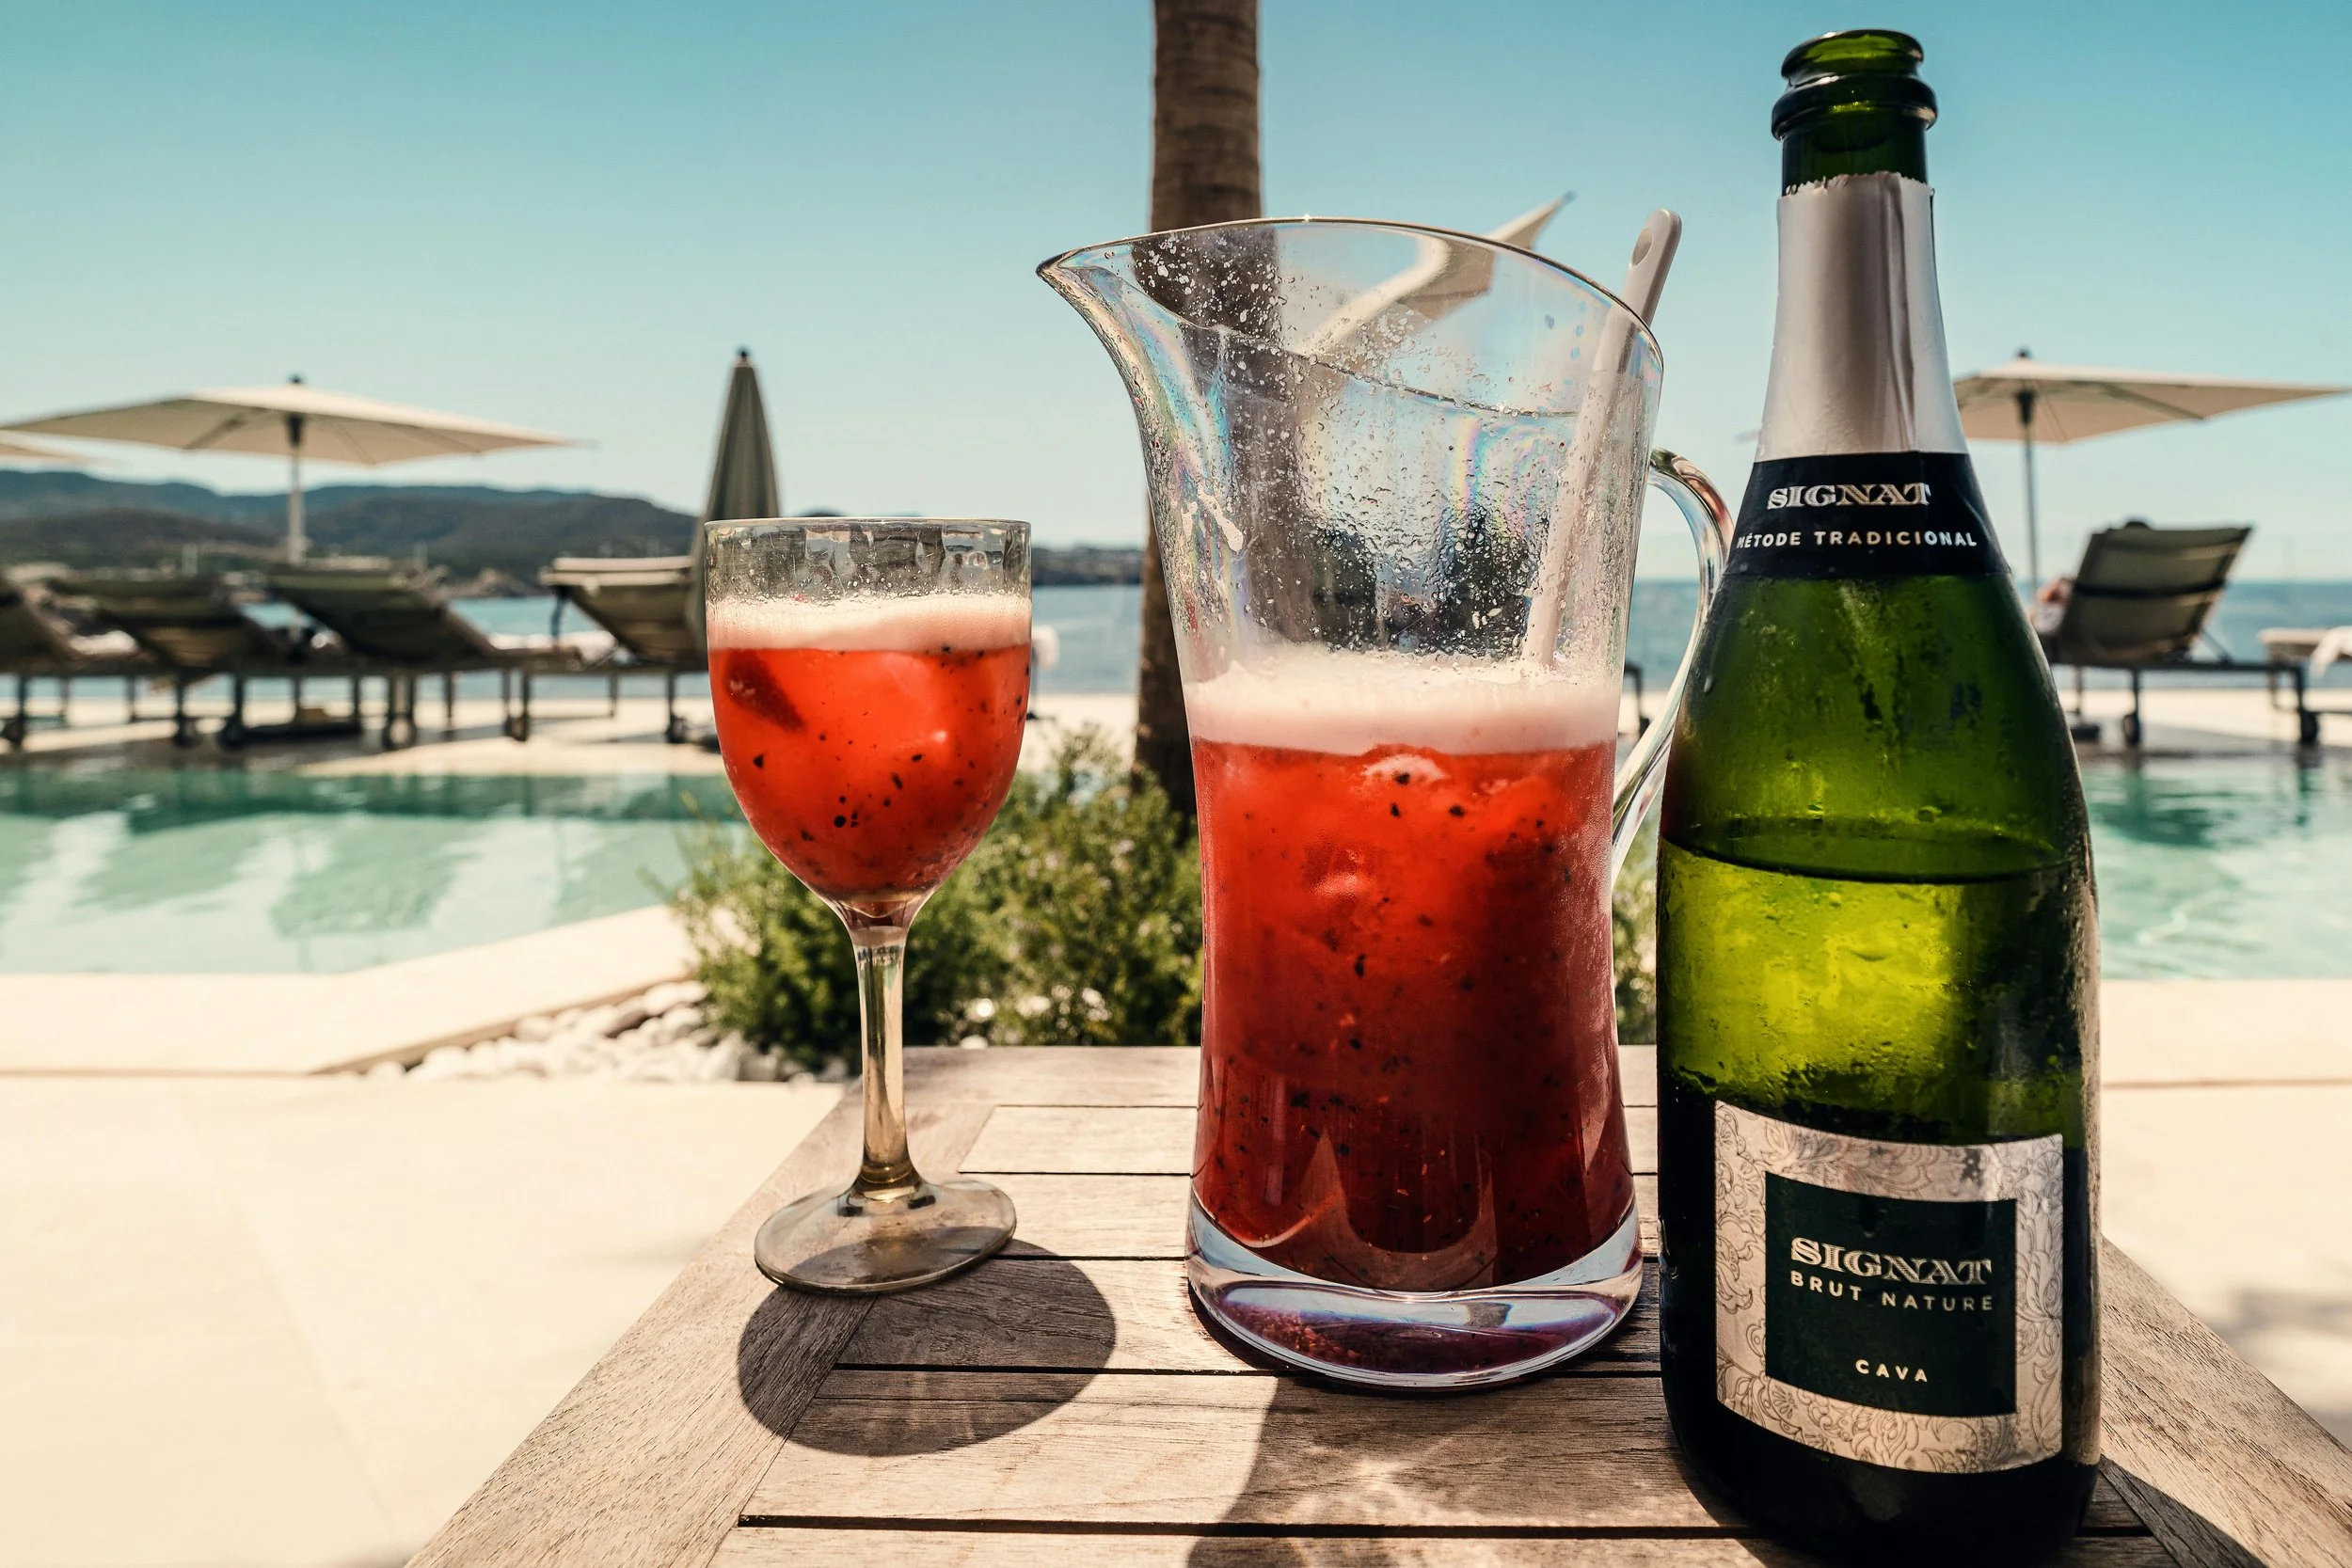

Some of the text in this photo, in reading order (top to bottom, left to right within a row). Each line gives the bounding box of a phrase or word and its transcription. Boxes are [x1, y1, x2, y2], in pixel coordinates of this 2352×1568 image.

[1767, 482, 1931, 510] SIGNAT
[1814, 531, 1978, 546] TRADICIONAL
[1790, 1237, 1992, 1286] SIGNAT
[1790, 1270, 1994, 1311] BRUT NATURE
[1855, 1359, 1928, 1383] CAVA
